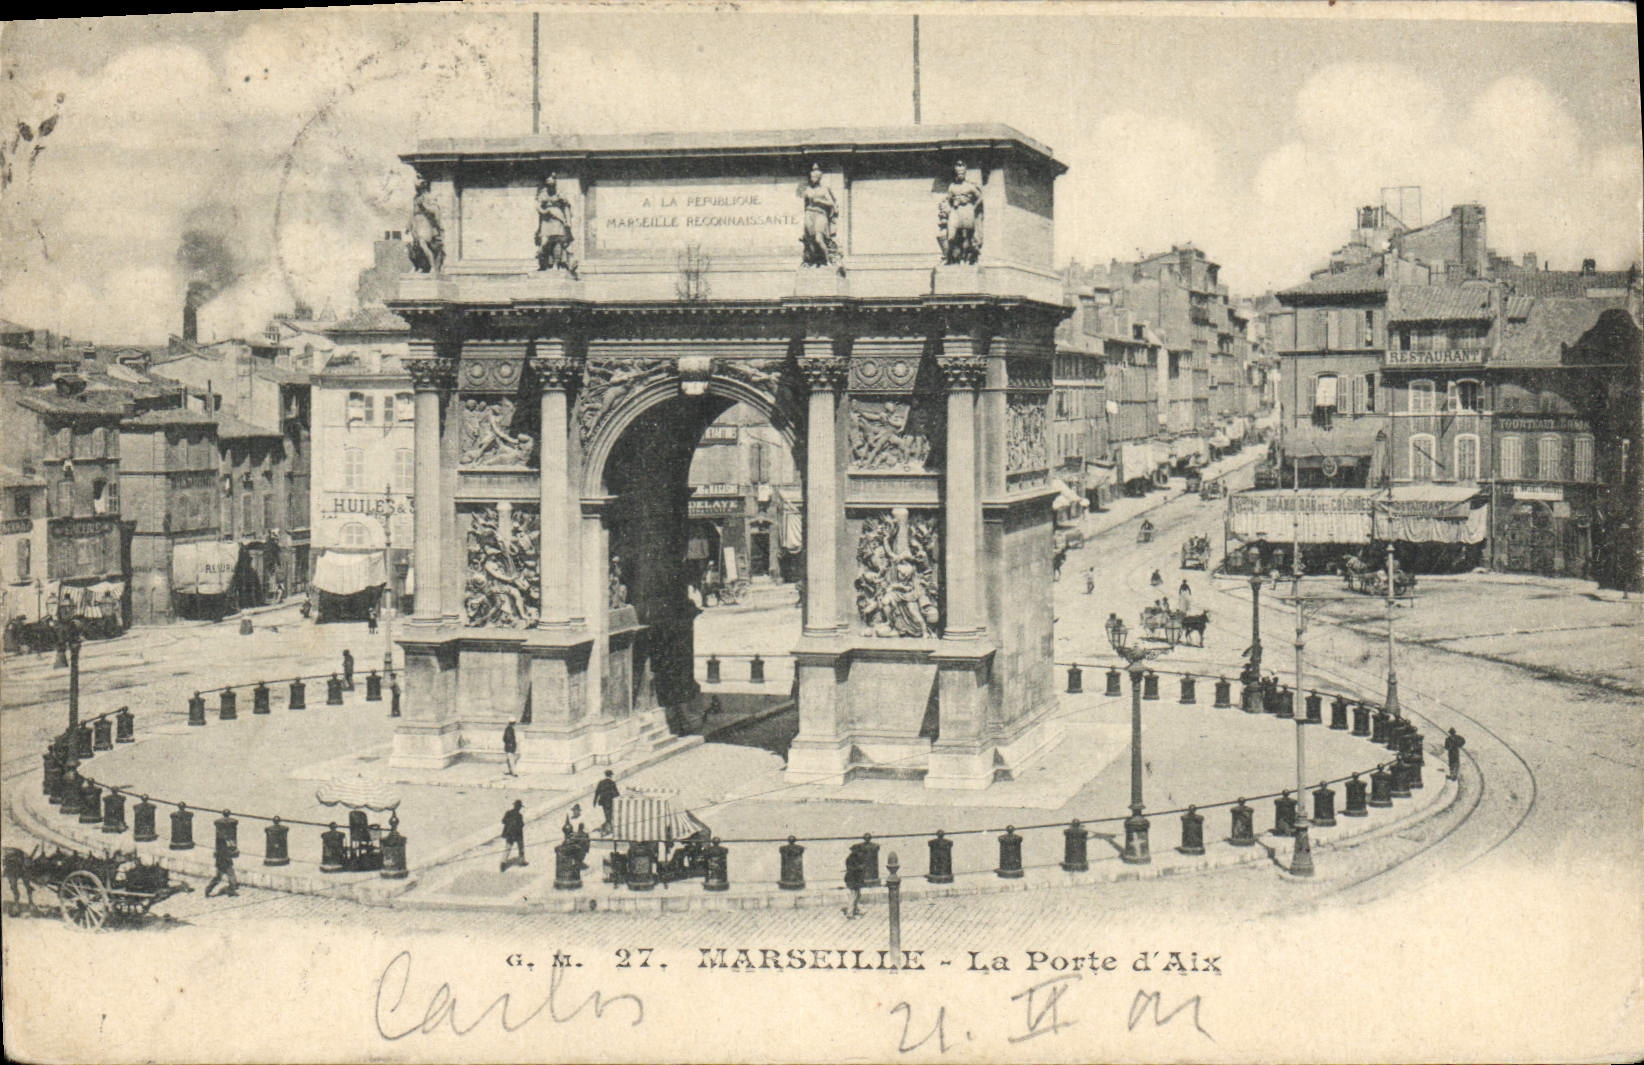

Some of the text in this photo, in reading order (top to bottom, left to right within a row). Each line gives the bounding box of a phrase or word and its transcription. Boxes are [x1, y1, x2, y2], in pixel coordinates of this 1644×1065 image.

[661, 197, 677, 207] LA
[606, 216, 799, 228] MARSEILLE RECONNAISSANTE
[1389, 350, 1480, 363] RESTAURANT
[333, 498, 395, 514] HUILES
